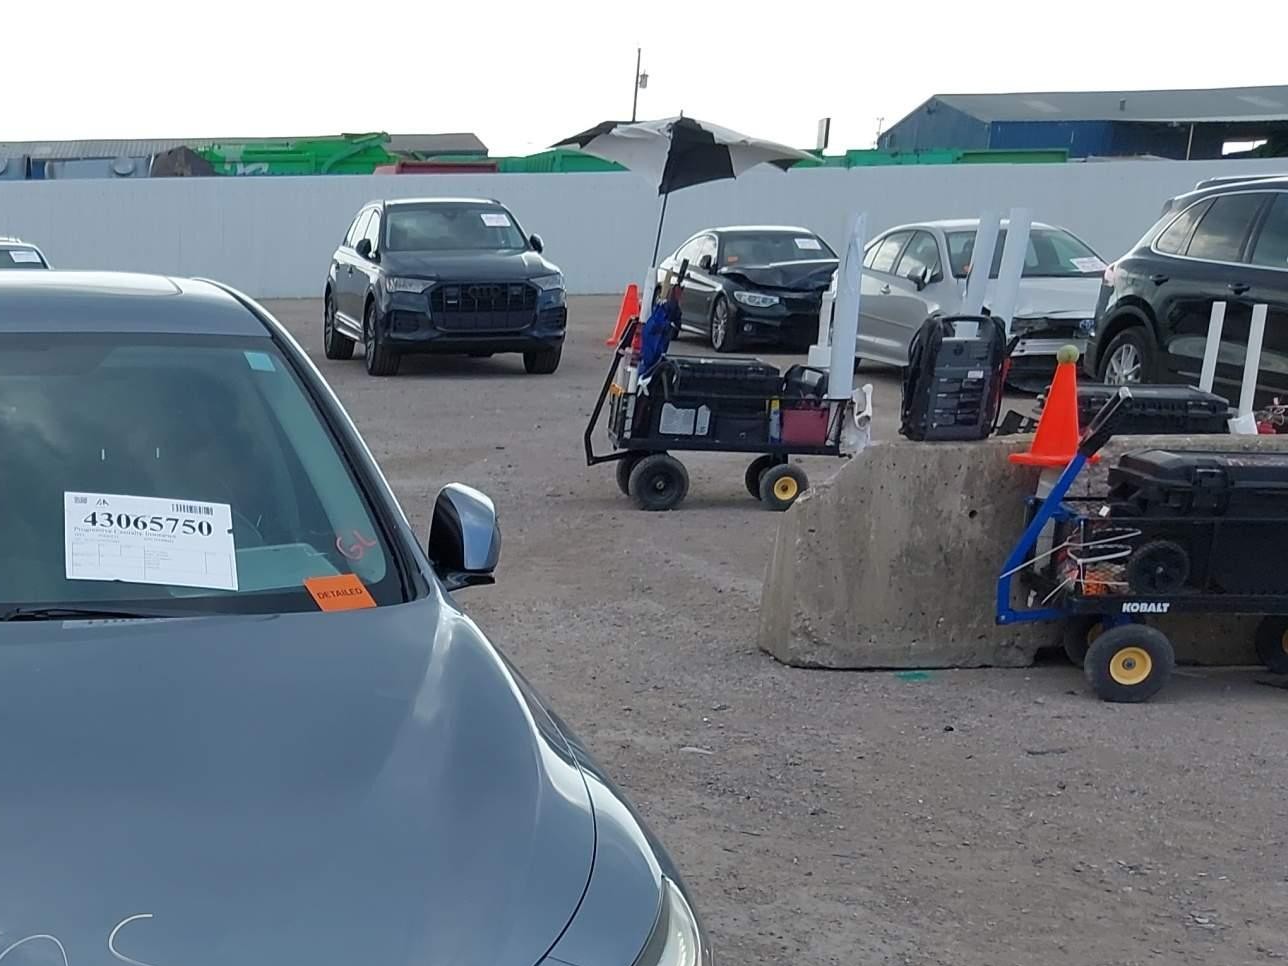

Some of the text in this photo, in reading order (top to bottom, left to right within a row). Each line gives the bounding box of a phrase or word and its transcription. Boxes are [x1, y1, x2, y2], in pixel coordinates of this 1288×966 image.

[83, 510, 213, 537] 43065750
[316, 587, 363, 599] DETAILED
[1121, 602, 1170, 613] KOBALT
